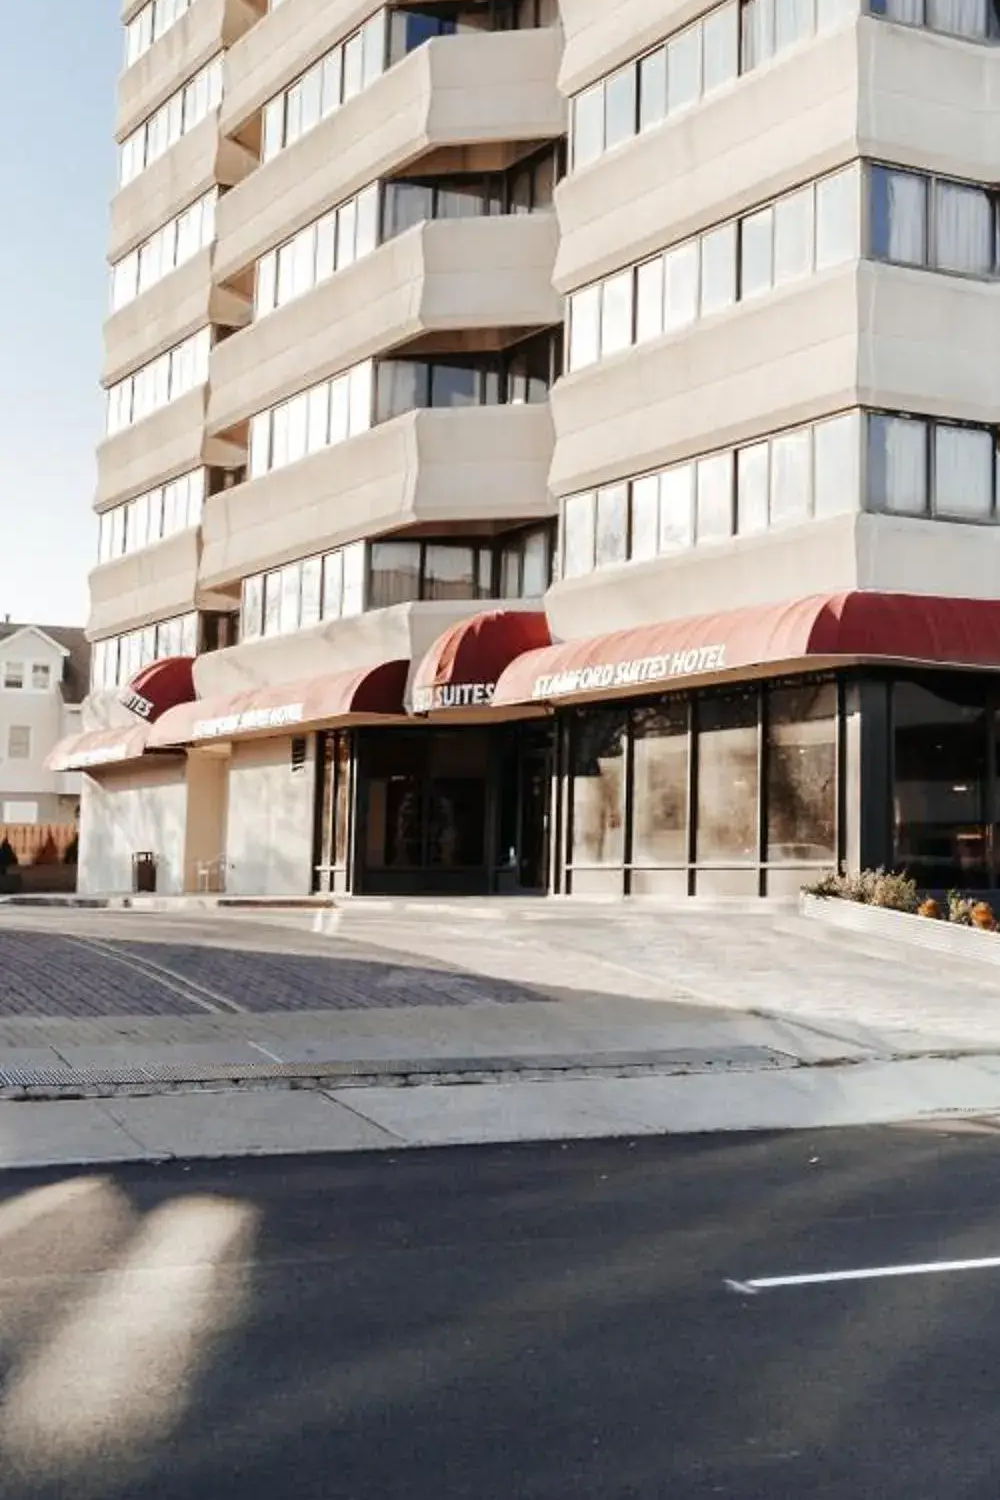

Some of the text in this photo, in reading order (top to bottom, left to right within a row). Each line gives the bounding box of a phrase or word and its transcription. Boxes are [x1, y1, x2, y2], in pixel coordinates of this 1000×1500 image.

[615, 654, 669, 686] SUITES
[670, 644, 726, 675] HOTEL
[434, 684, 497, 709] SUITES
